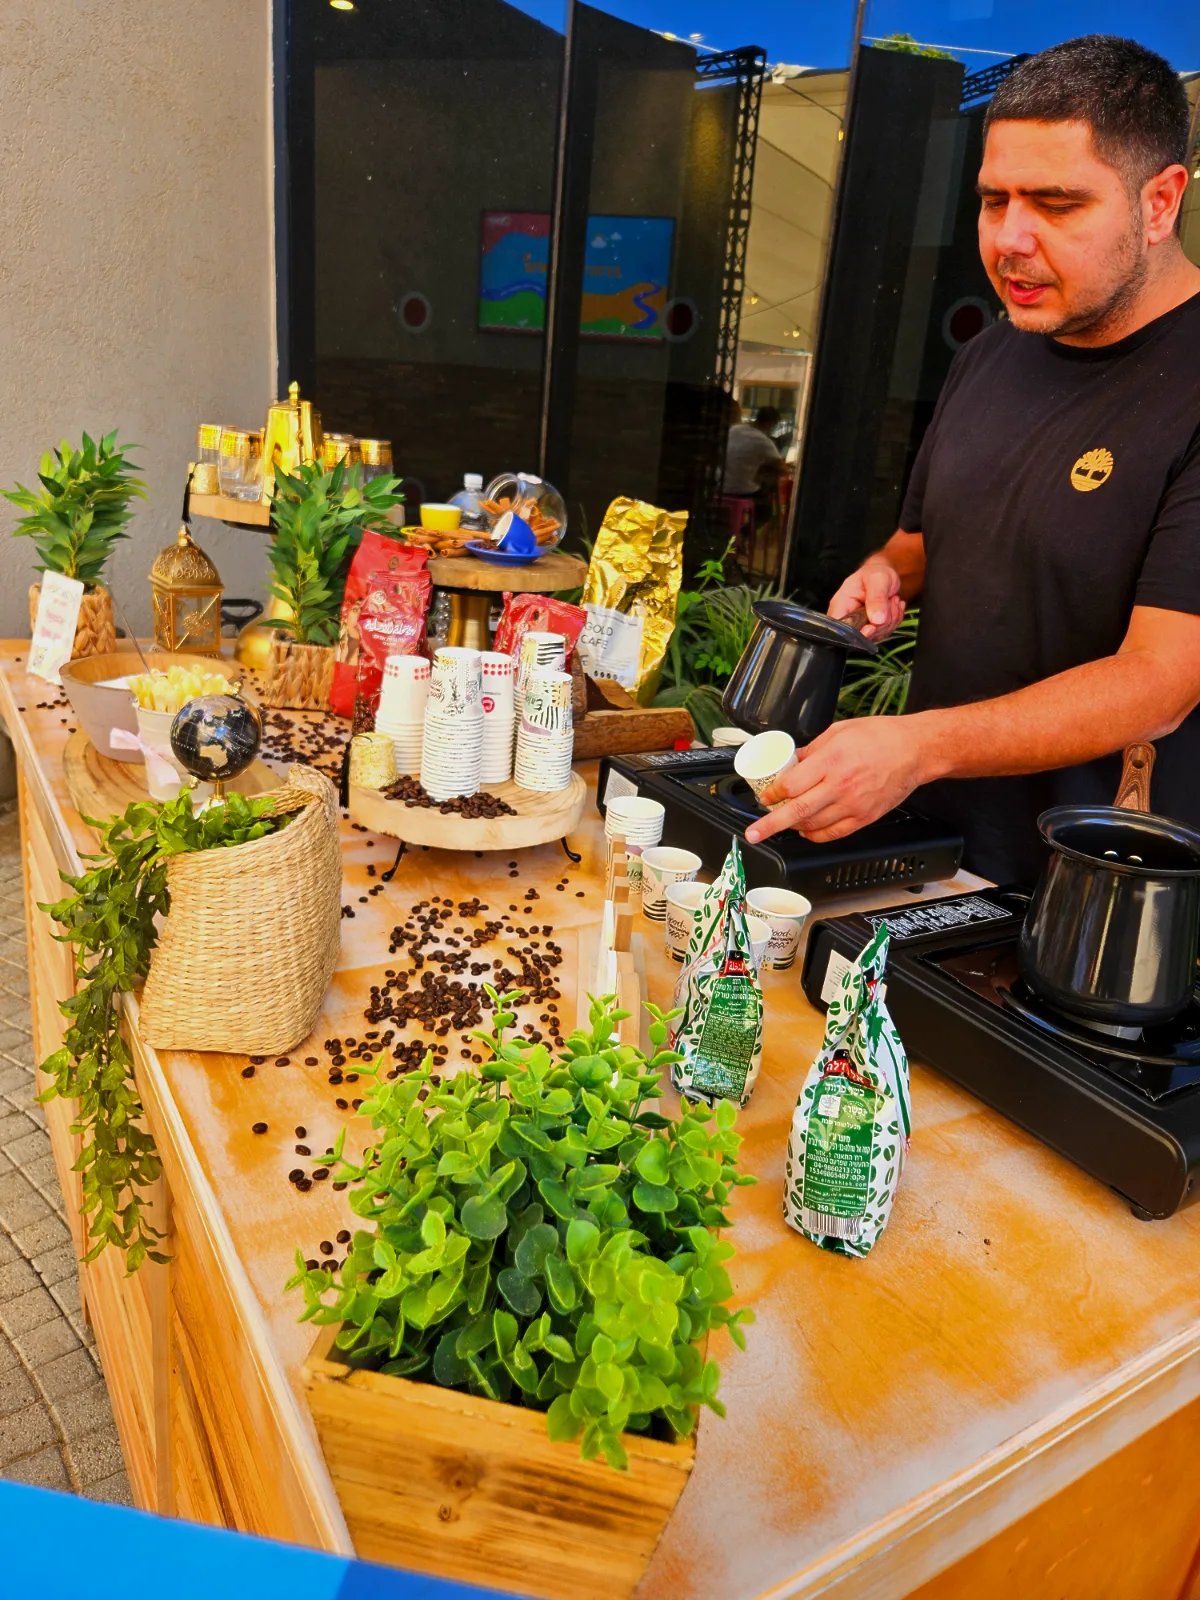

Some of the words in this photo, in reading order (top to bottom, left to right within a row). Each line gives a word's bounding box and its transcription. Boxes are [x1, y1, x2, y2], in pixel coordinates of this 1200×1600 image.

[584, 621, 614, 637] GOLD
[580, 634, 609, 650] CAFE
[817, 1204, 829, 1212] 250
